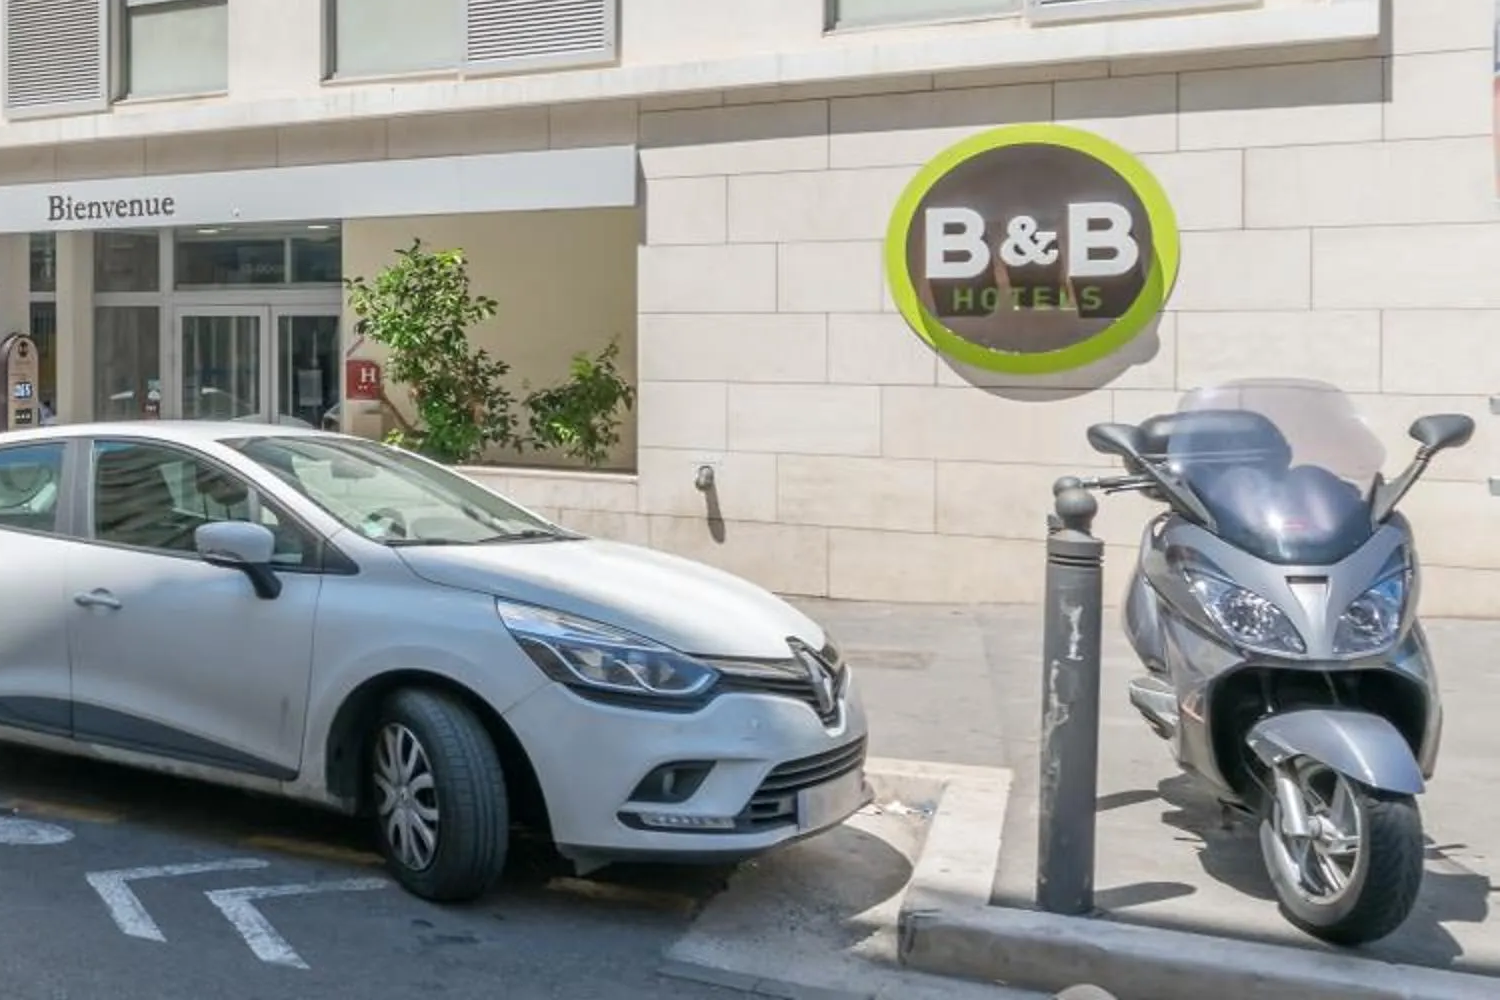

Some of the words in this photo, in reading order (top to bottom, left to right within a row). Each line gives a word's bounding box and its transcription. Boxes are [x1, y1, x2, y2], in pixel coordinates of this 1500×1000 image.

[48, 195, 175, 220] Bienvenue
[925, 201, 1140, 279] B&B
[952, 285, 1104, 312] HOTELS
[361, 367, 376, 383] H
